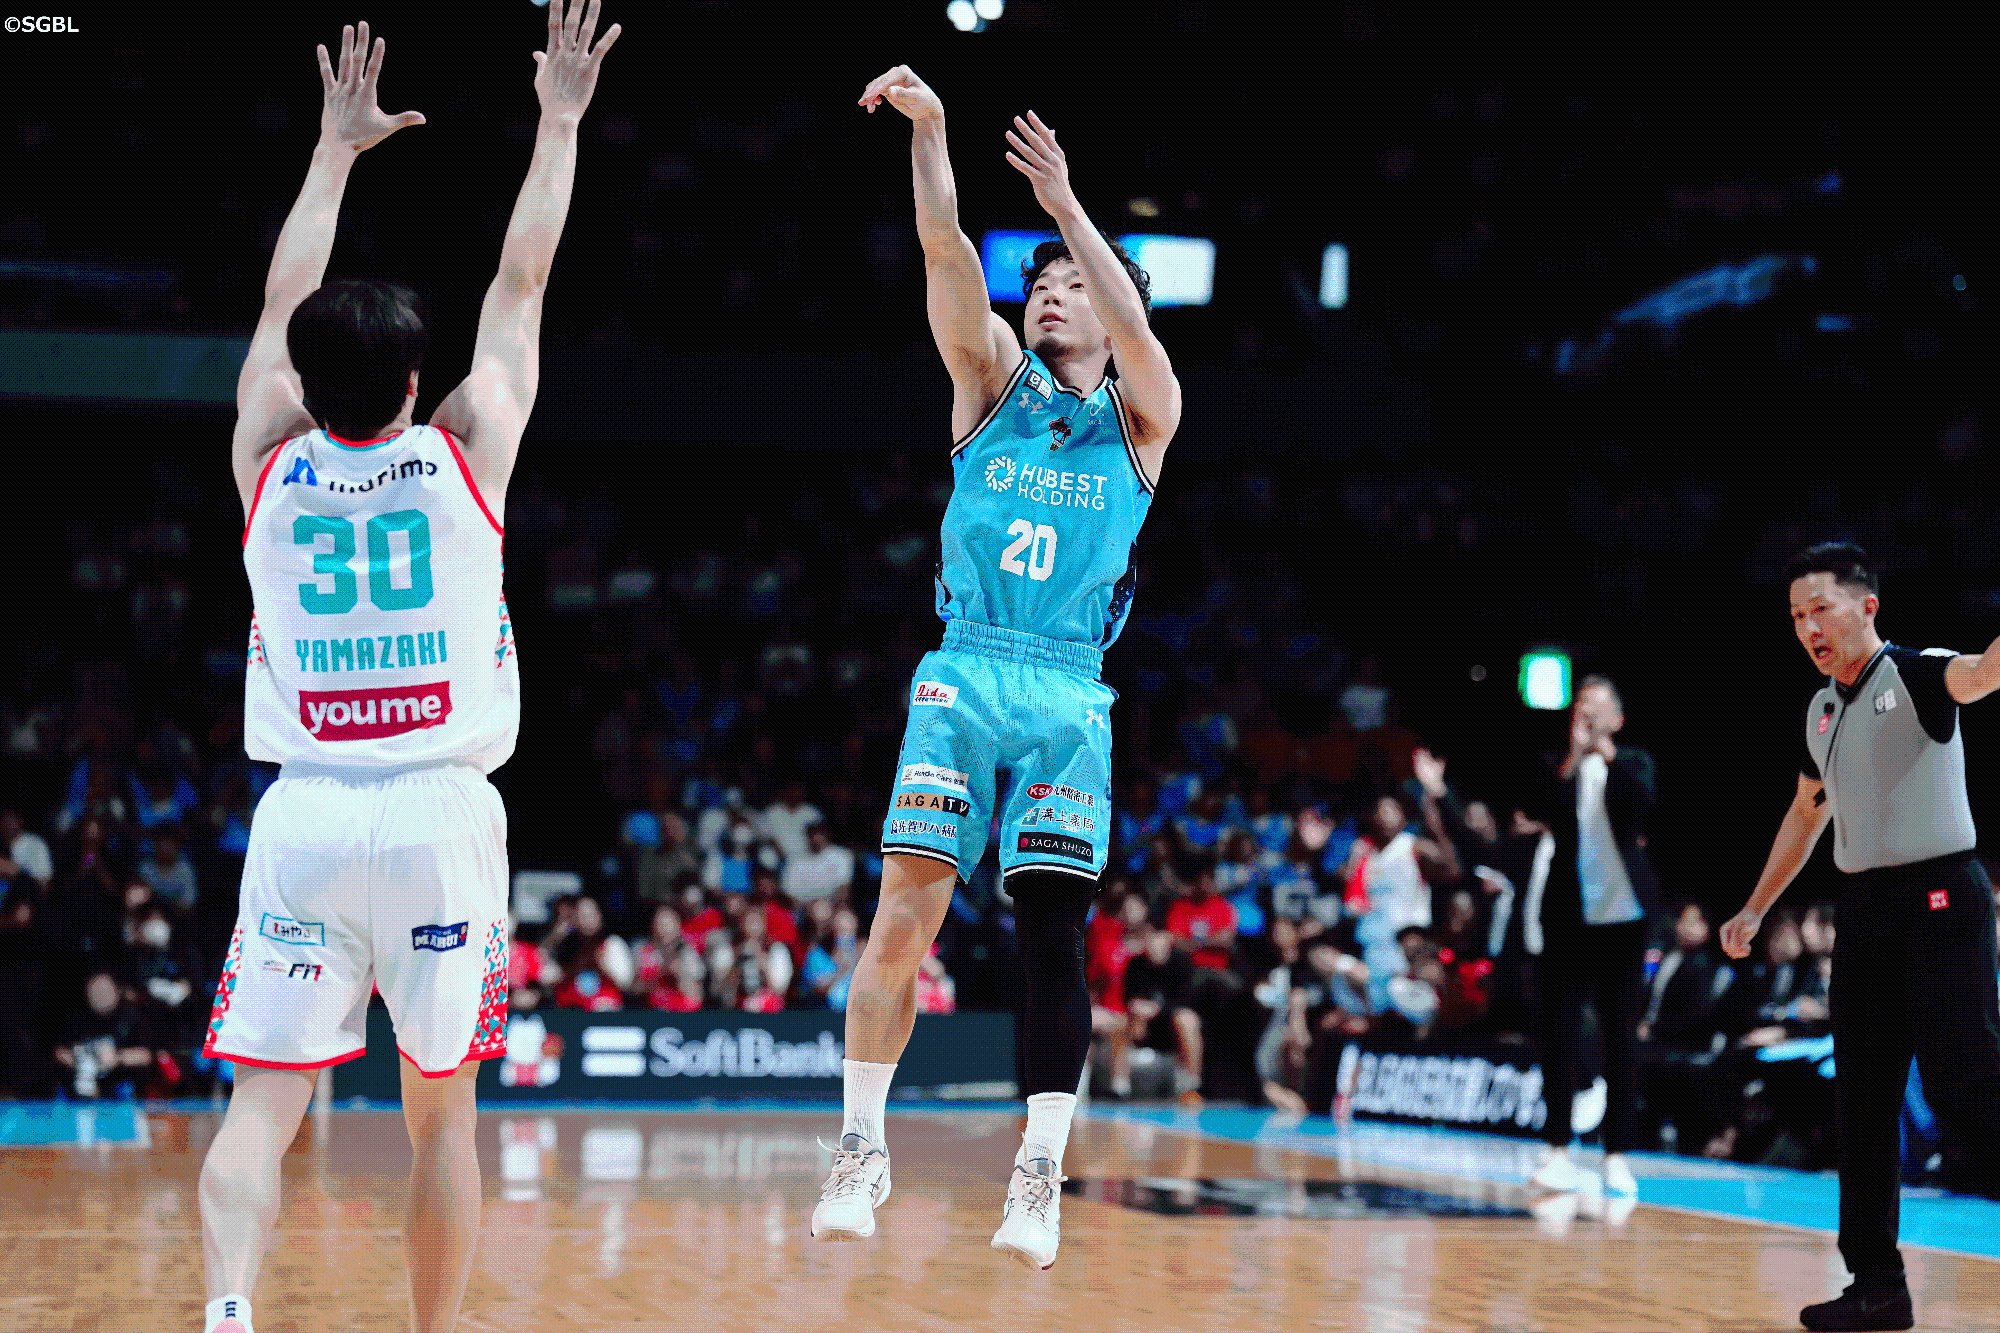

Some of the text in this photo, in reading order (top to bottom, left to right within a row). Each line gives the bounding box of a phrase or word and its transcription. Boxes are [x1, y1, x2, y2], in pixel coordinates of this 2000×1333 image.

[1018, 481, 1106, 511] HOLDING
[1020, 463, 1108, 494] HUBEST
[293, 508, 435, 615] 30
[999, 518, 1058, 582] 20
[295, 630, 448, 673] YAMAZAKI
[306, 694, 442, 734] youme
[896, 795, 969, 815] SAGA TV
[1029, 786, 1053, 797] KSK
[1030, 838, 1093, 857] SAGA SHUZO
[648, 1026, 845, 1079] SoftBank
